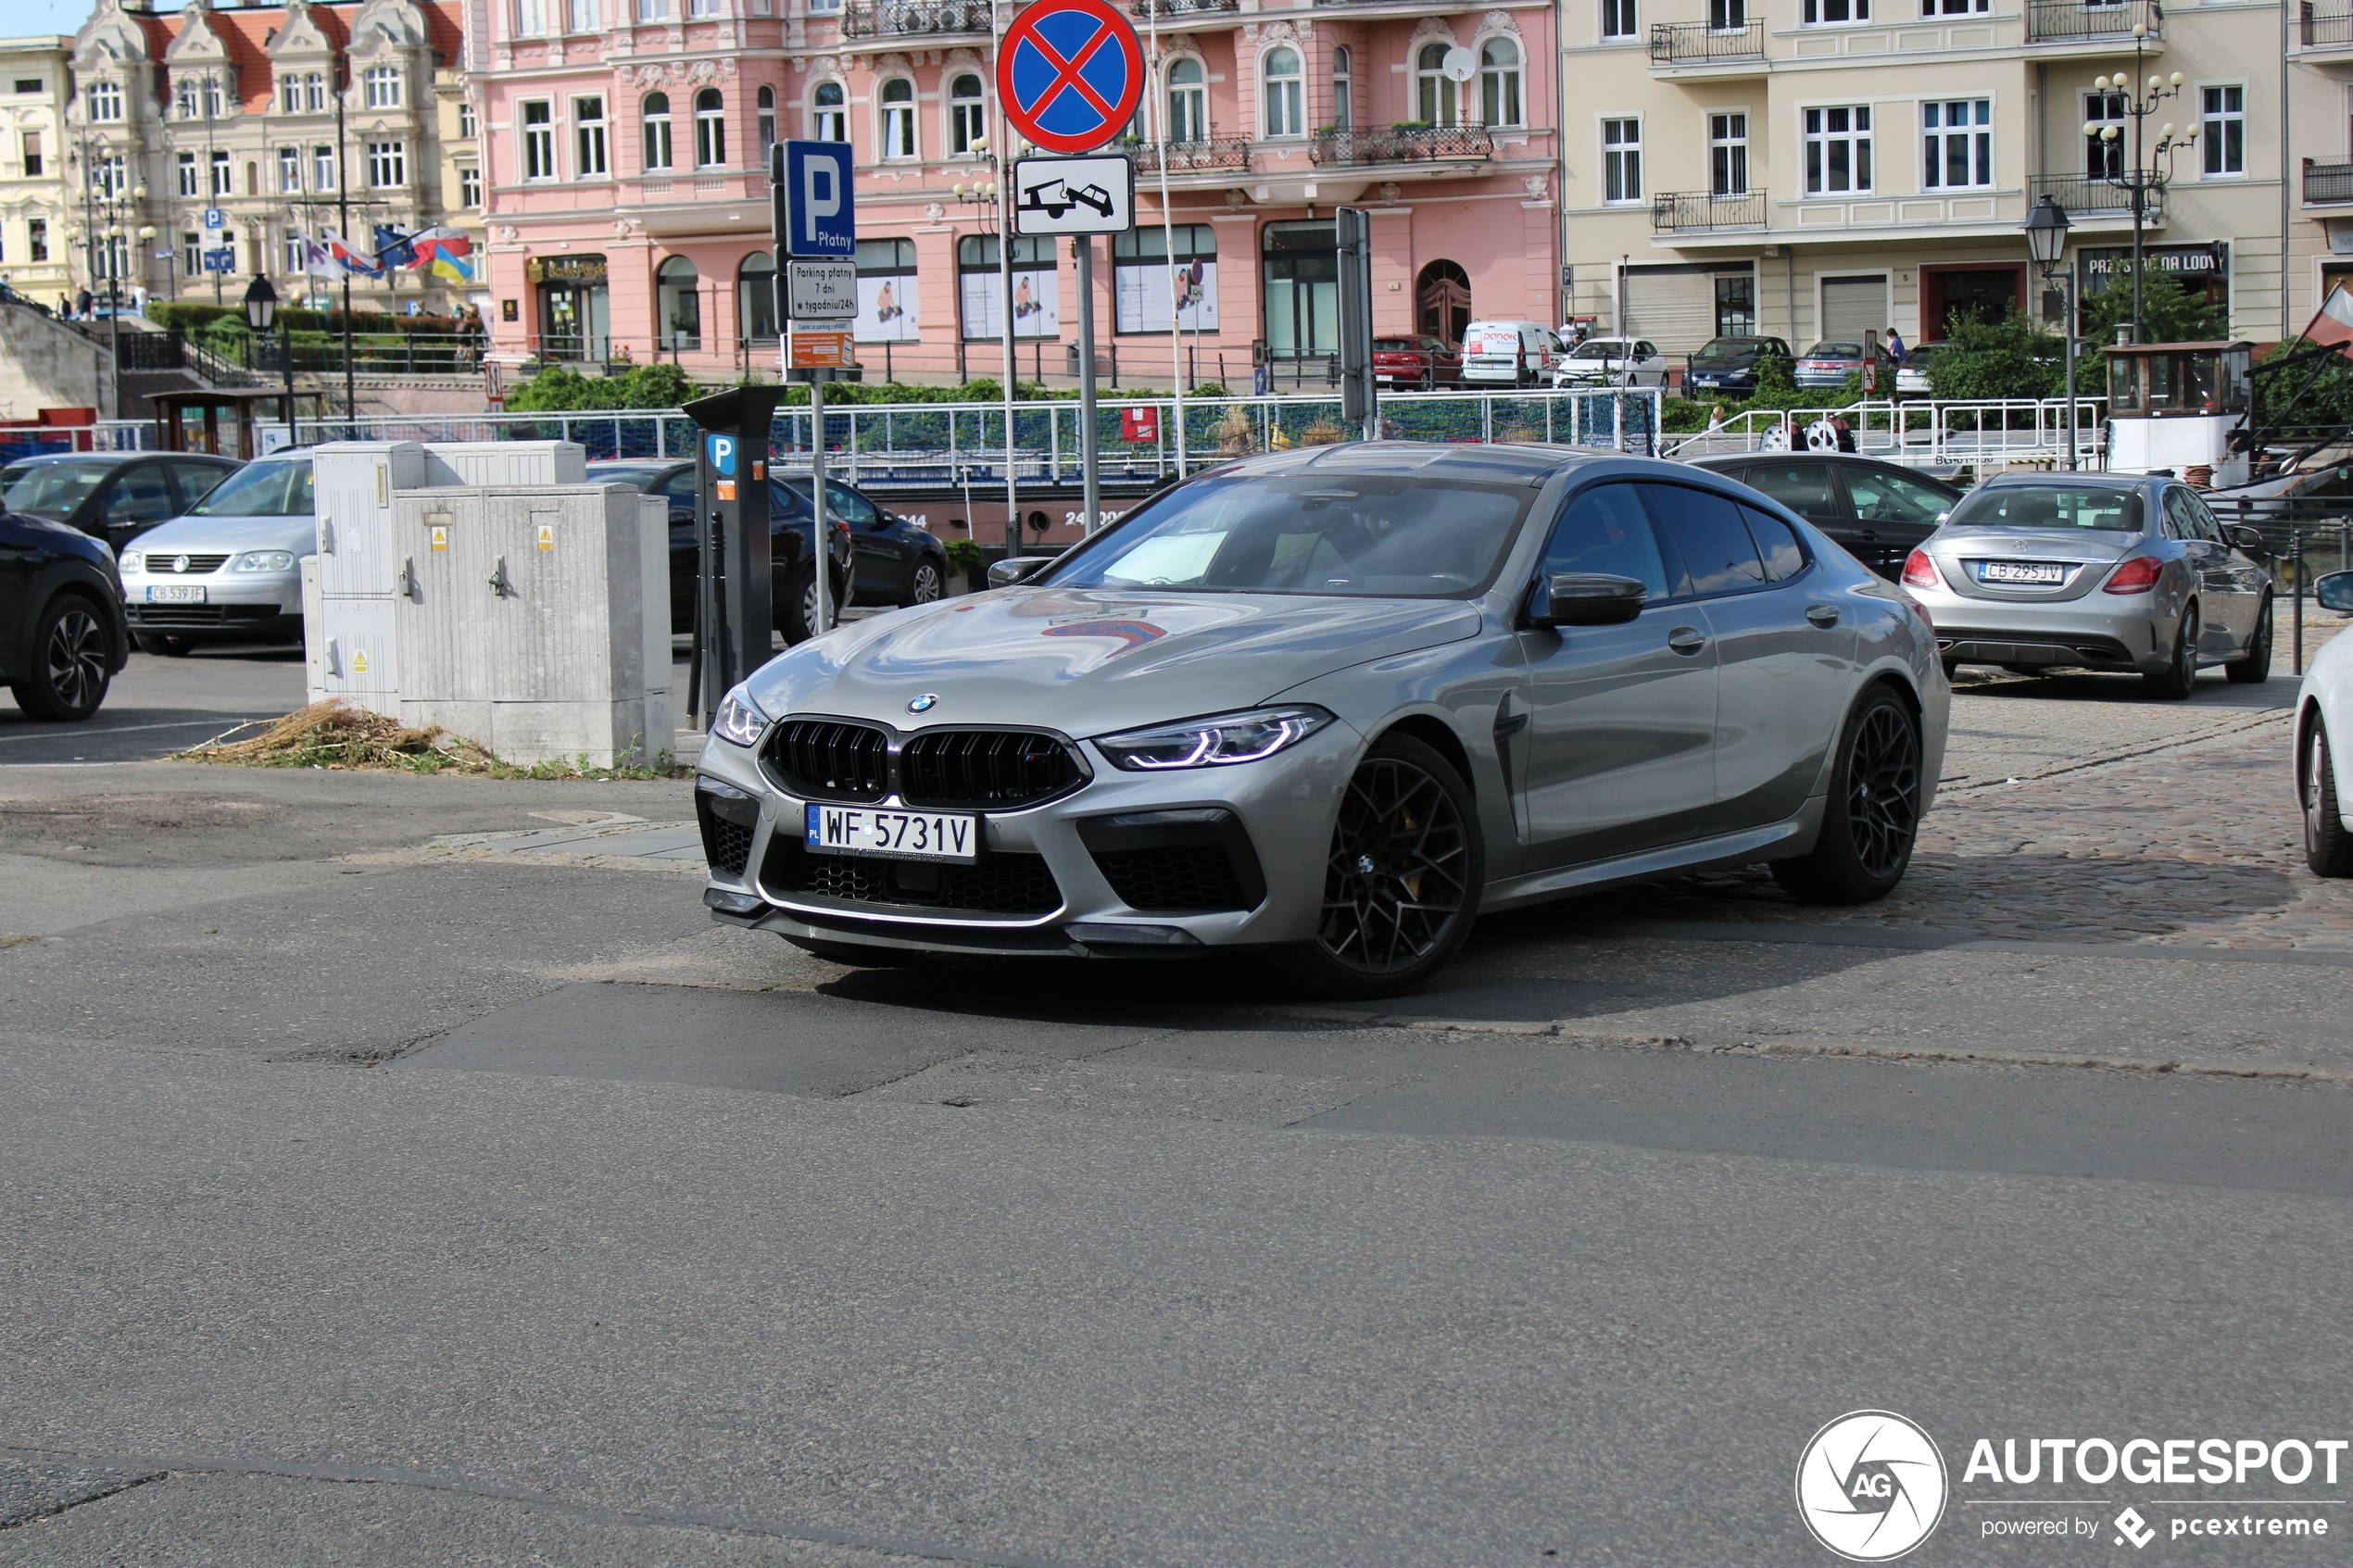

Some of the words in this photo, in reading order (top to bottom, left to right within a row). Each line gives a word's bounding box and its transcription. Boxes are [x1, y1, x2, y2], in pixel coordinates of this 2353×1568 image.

[803, 155, 840, 241] P
[819, 232, 851, 251] Płatny
[548, 263, 574, 278] Bank
[577, 261, 607, 277] Polski
[2161, 257, 2179, 270] NA
[797, 267, 825, 281] Parking
[828, 267, 852, 281] płatny
[1564, 269, 1570, 283] P
[815, 283, 820, 294] 7
[823, 282, 835, 294] dni
[805, 299, 854, 313] tygodniu/24h
[1483, 332, 1517, 342] panek
[715, 438, 732, 468] P
[1989, 563, 2007, 577] CB
[2013, 564, 2058, 580] 295JV
[154, 587, 167, 599] CB
[826, 809, 862, 845] WF
[875, 813, 967, 853] 5731V
